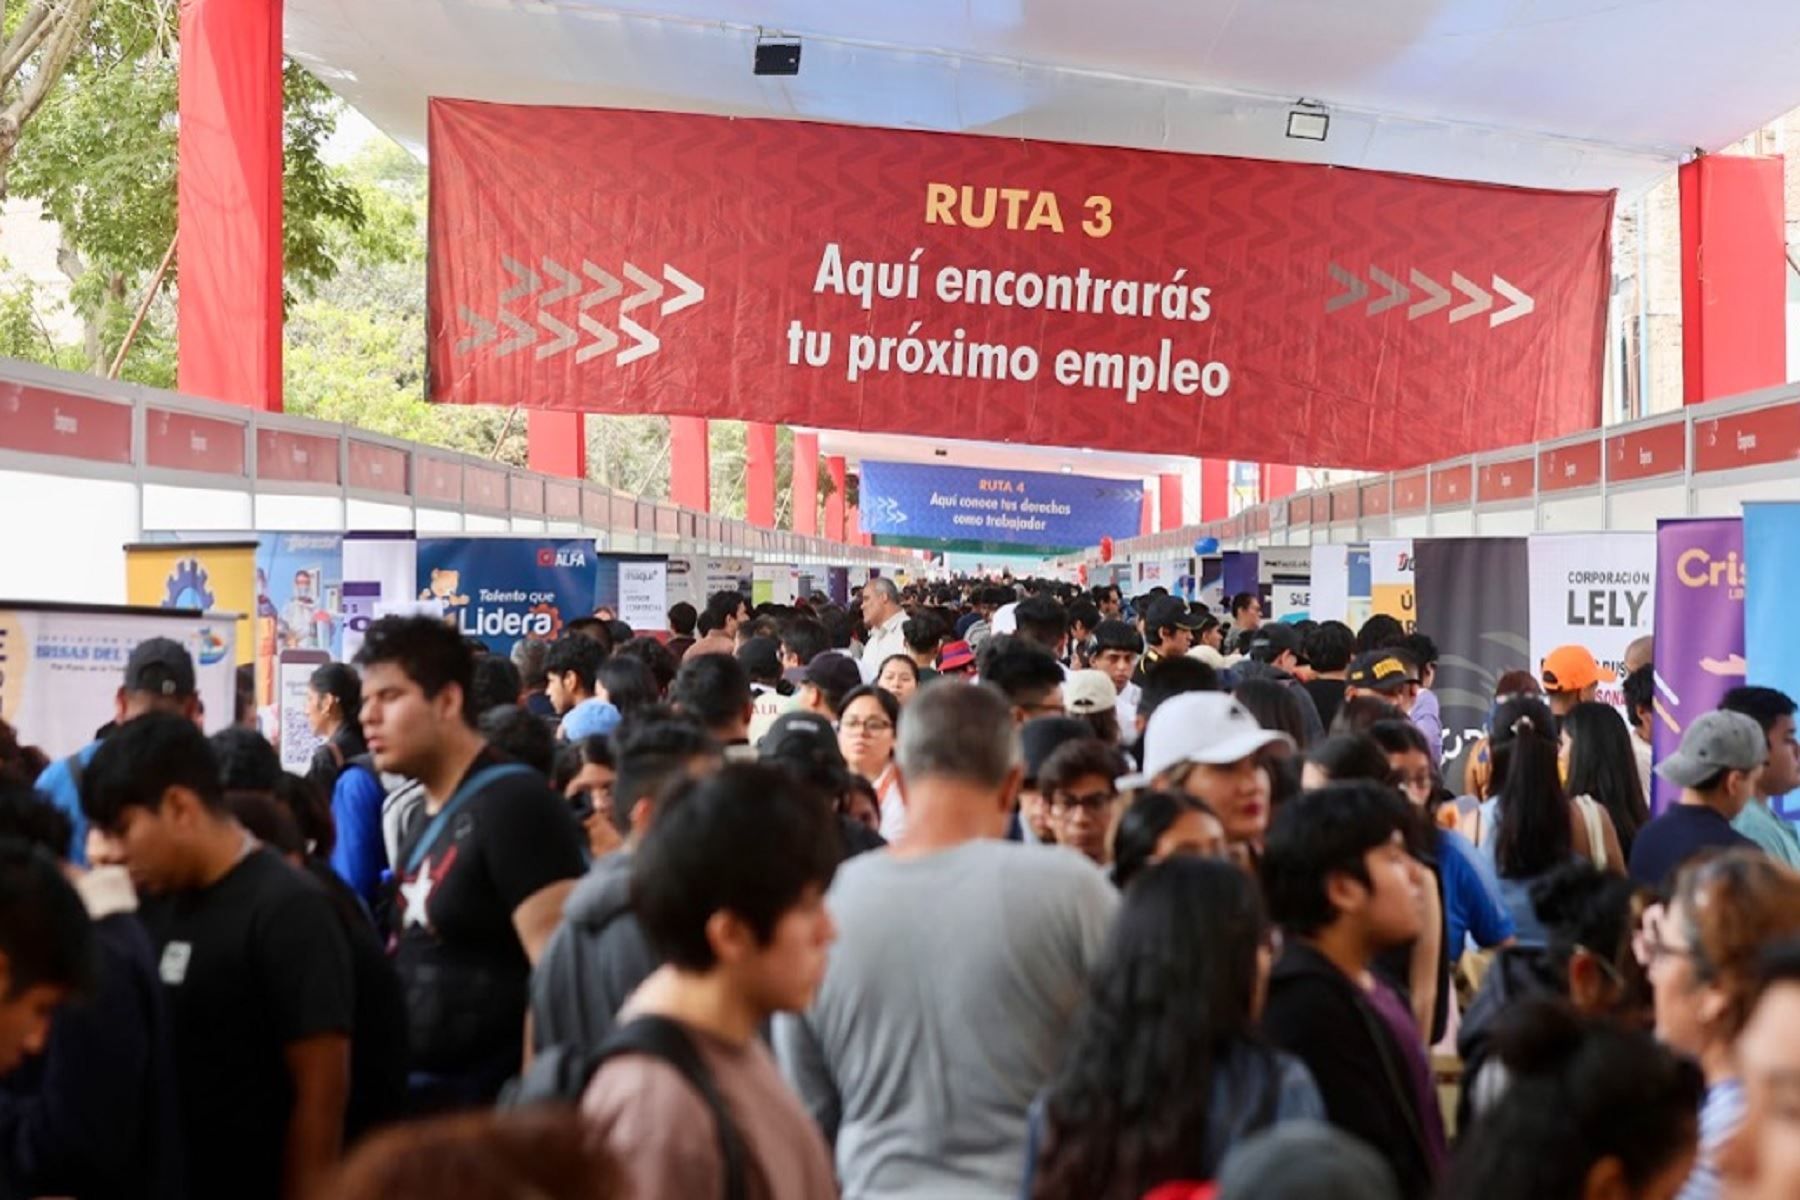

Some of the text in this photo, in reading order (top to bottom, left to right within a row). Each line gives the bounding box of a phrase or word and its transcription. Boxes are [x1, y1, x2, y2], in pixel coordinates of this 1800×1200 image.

[925, 183, 1113, 238] RUTA 3
[813, 243, 1212, 322] Aquí encontrarás
[787, 320, 1230, 404] tu próximo empleo
[978, 479, 1025, 493] RUTA 4
[930, 492, 1071, 515] Aquí conoce tus derechos
[953, 514, 1046, 531] como trabajador
[554, 552, 586, 567] ALFA
[1677, 548, 1744, 588] Cri
[480, 589, 555, 604] Talento que
[1567, 590, 1648, 627] LELY
[458, 607, 552, 636] Lidera
